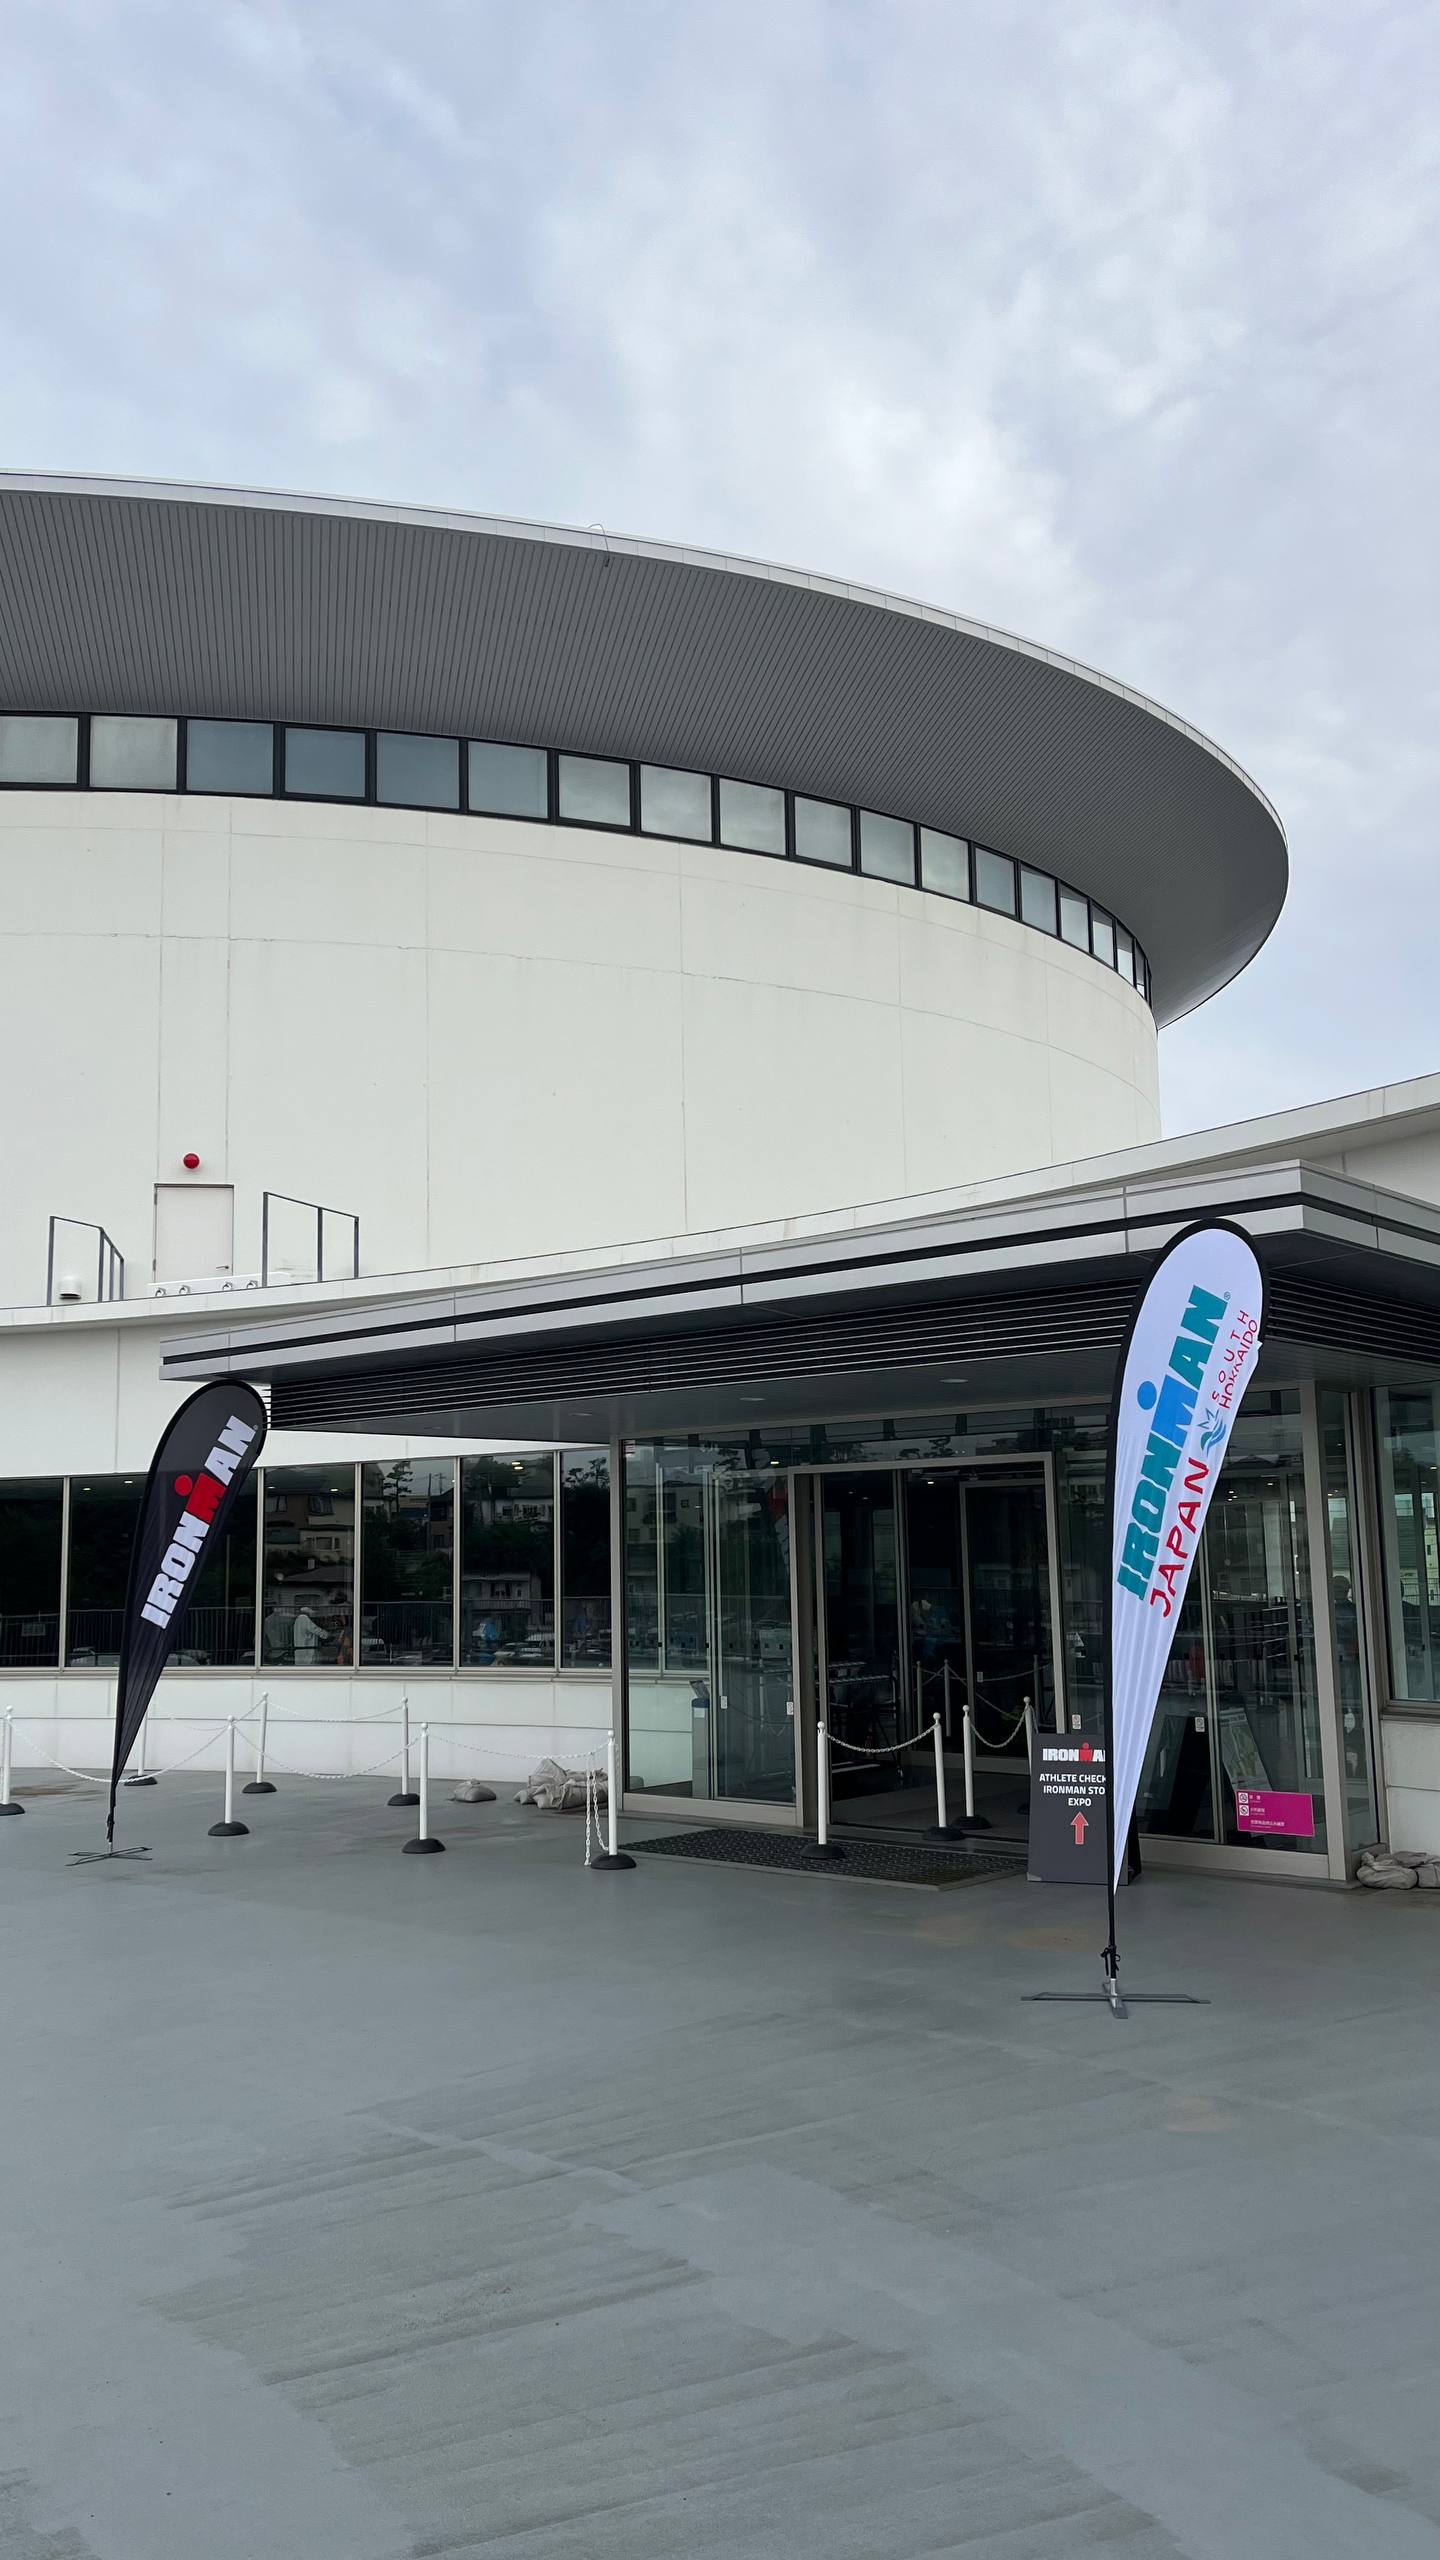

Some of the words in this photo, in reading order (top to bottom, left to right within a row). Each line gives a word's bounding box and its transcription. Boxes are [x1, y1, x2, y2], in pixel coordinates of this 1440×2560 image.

[1212, 1310, 1249, 1400] SOUTH
[140, 1415, 256, 1629] IRONMAN
[1150, 1457, 1210, 1618] JAPAN
[1042, 1743, 1106, 1762] IRONMA
[1039, 1773, 1078, 1783] ATHLETE
[1043, 1785, 1087, 1795] IRONMAN
[1068, 1798, 1092, 1807] EXPO
